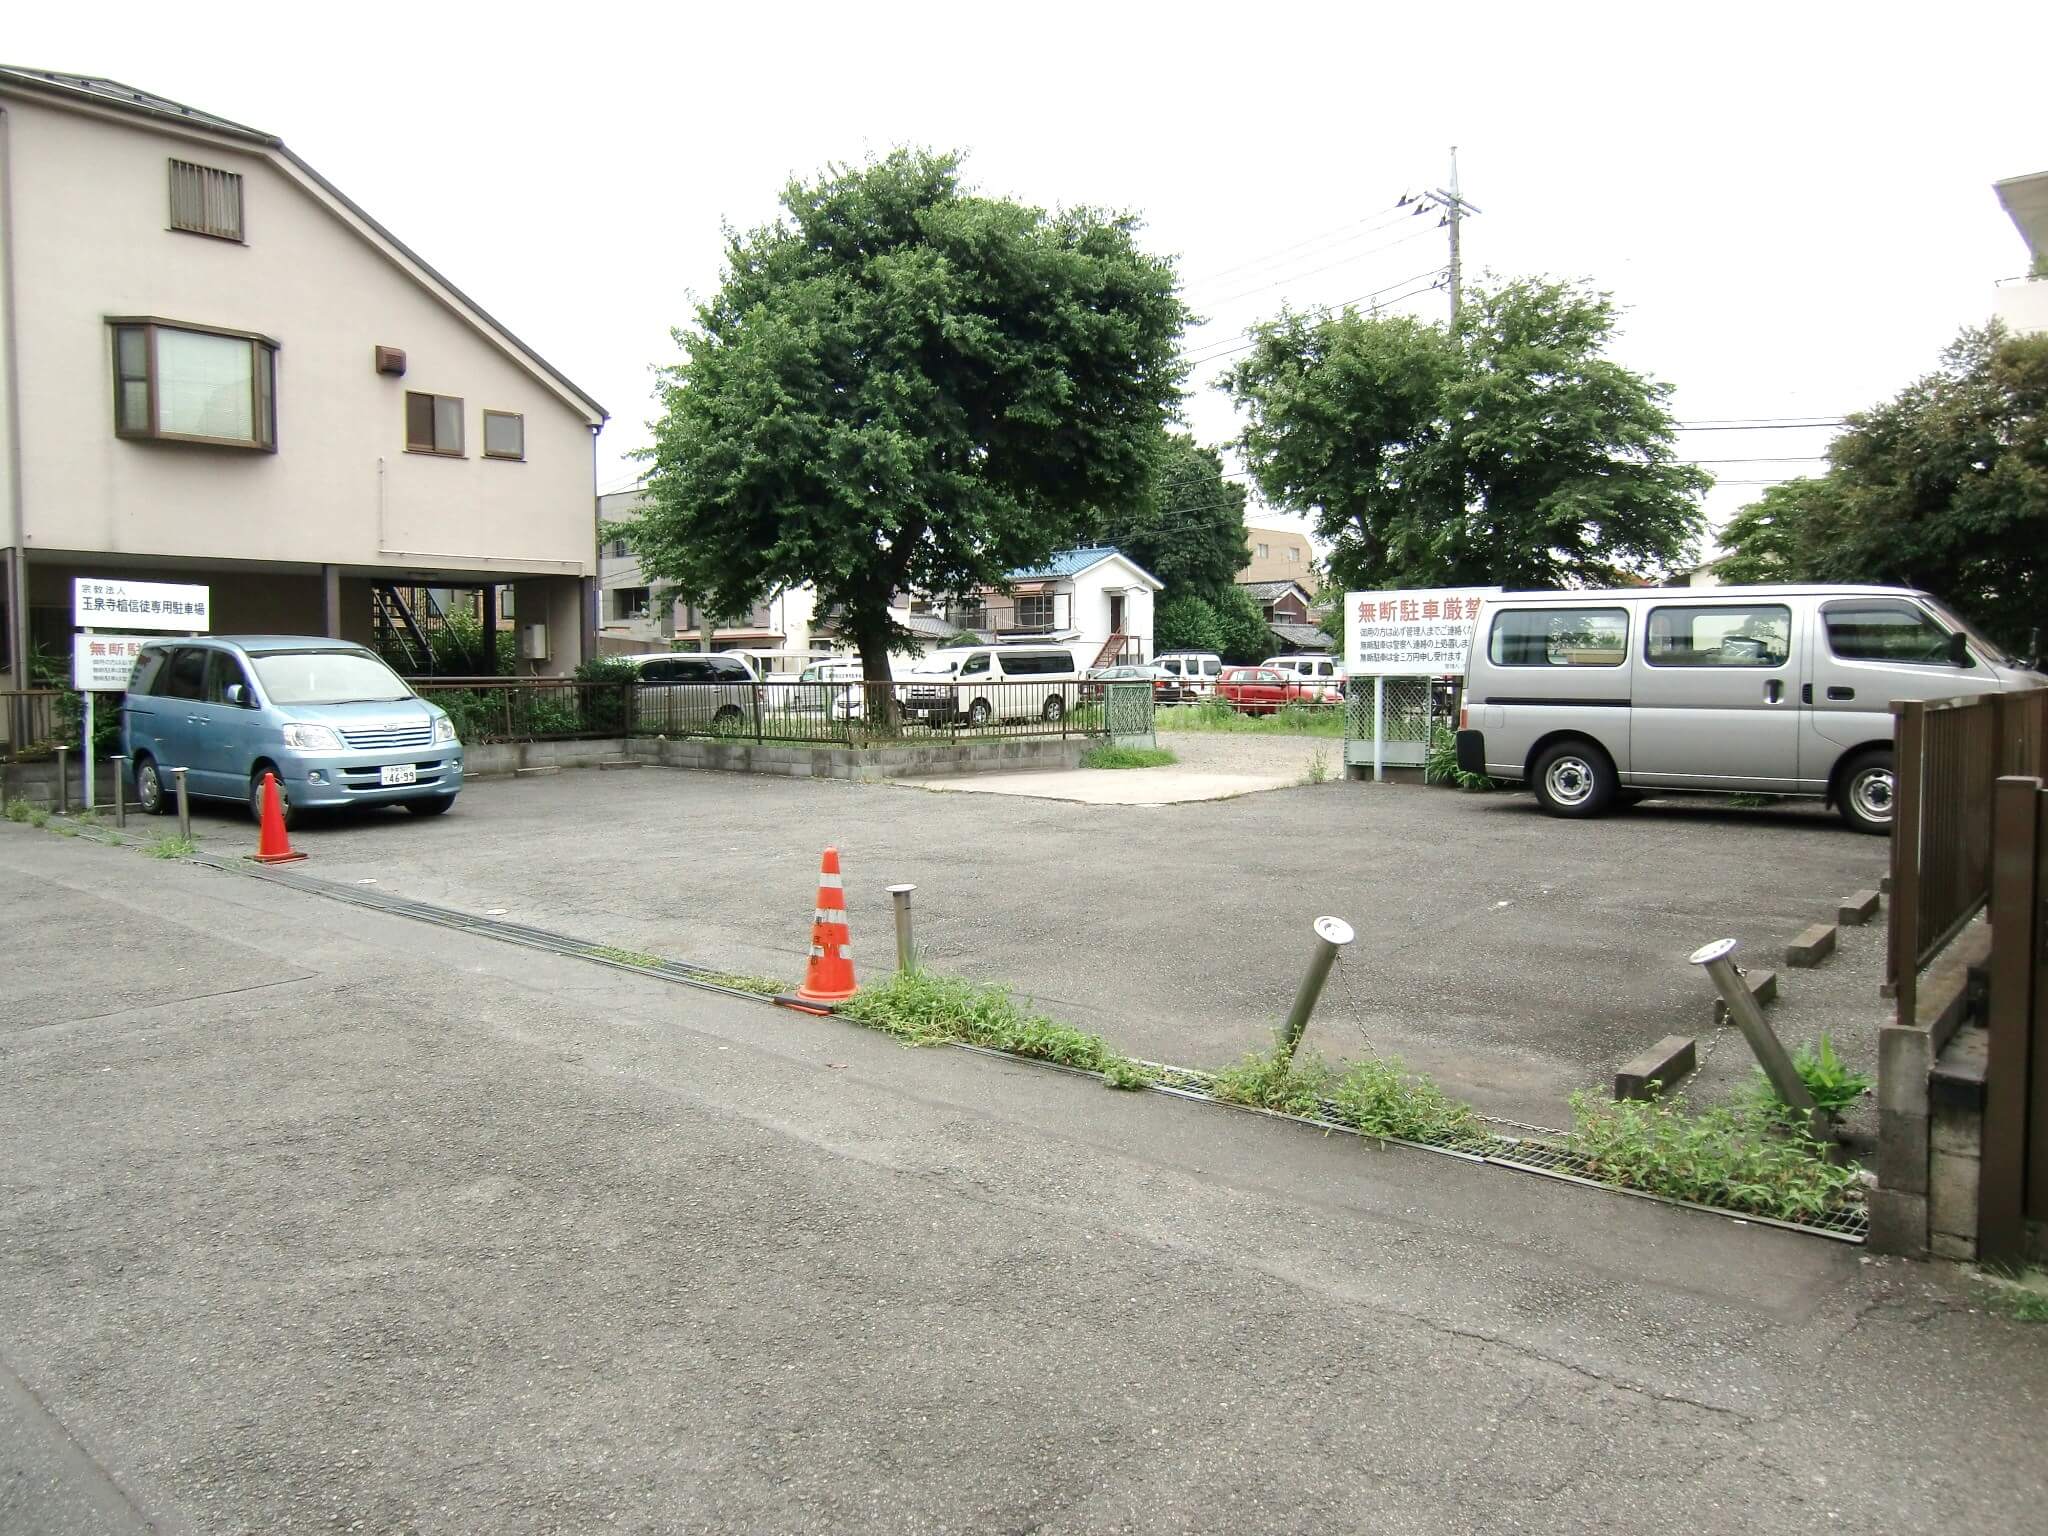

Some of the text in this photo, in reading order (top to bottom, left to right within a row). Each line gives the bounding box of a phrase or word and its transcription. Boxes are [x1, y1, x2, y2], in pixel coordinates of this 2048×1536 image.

[82, 584, 126, 595] 宗教法人
[1358, 597, 1481, 623] 無断駐車厳禁
[389, 771, 415, 783] 46-99
